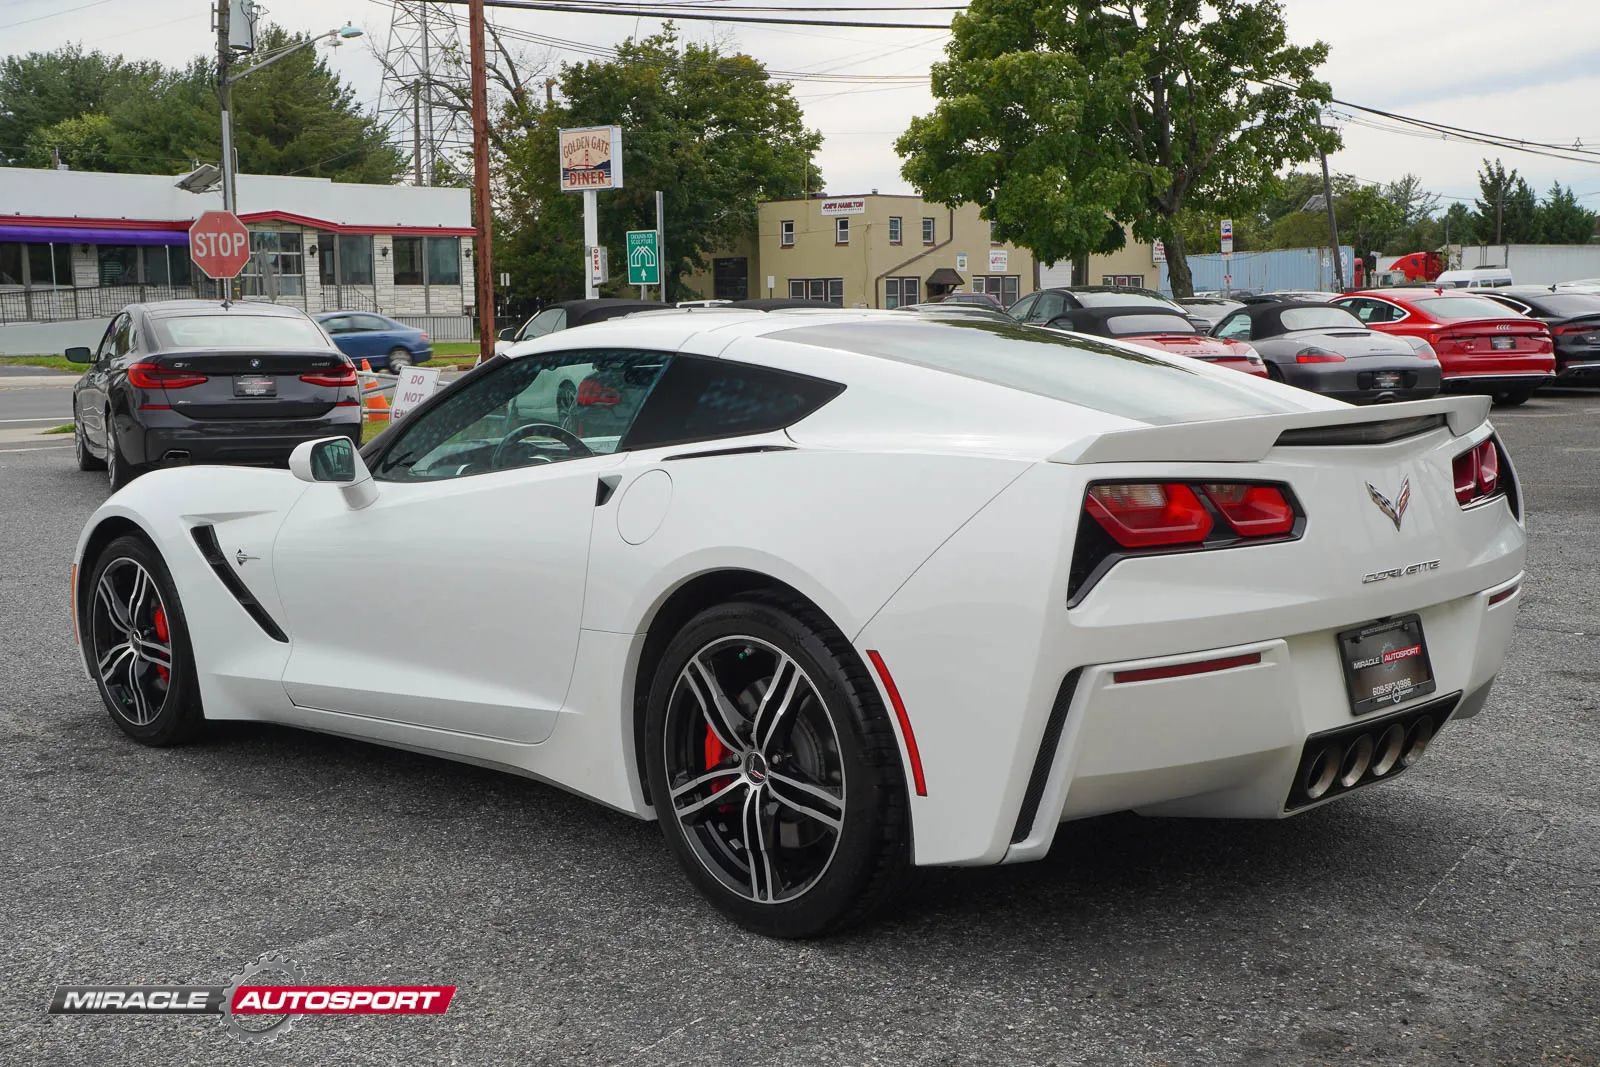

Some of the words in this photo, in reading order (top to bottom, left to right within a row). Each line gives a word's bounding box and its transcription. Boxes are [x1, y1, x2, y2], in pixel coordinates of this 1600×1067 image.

[563, 135, 590, 158] GOLDEN
[591, 135, 610, 156] GATE
[569, 170, 606, 186] DINER
[195, 232, 245, 257] STOP
[410, 375, 424, 385] DO
[403, 391, 424, 403] NOT
[1362, 558, 1440, 584] CORVETTE
[1353, 656, 1381, 669] MIRACLE
[1384, 646, 1419, 661] AUTOSPORT
